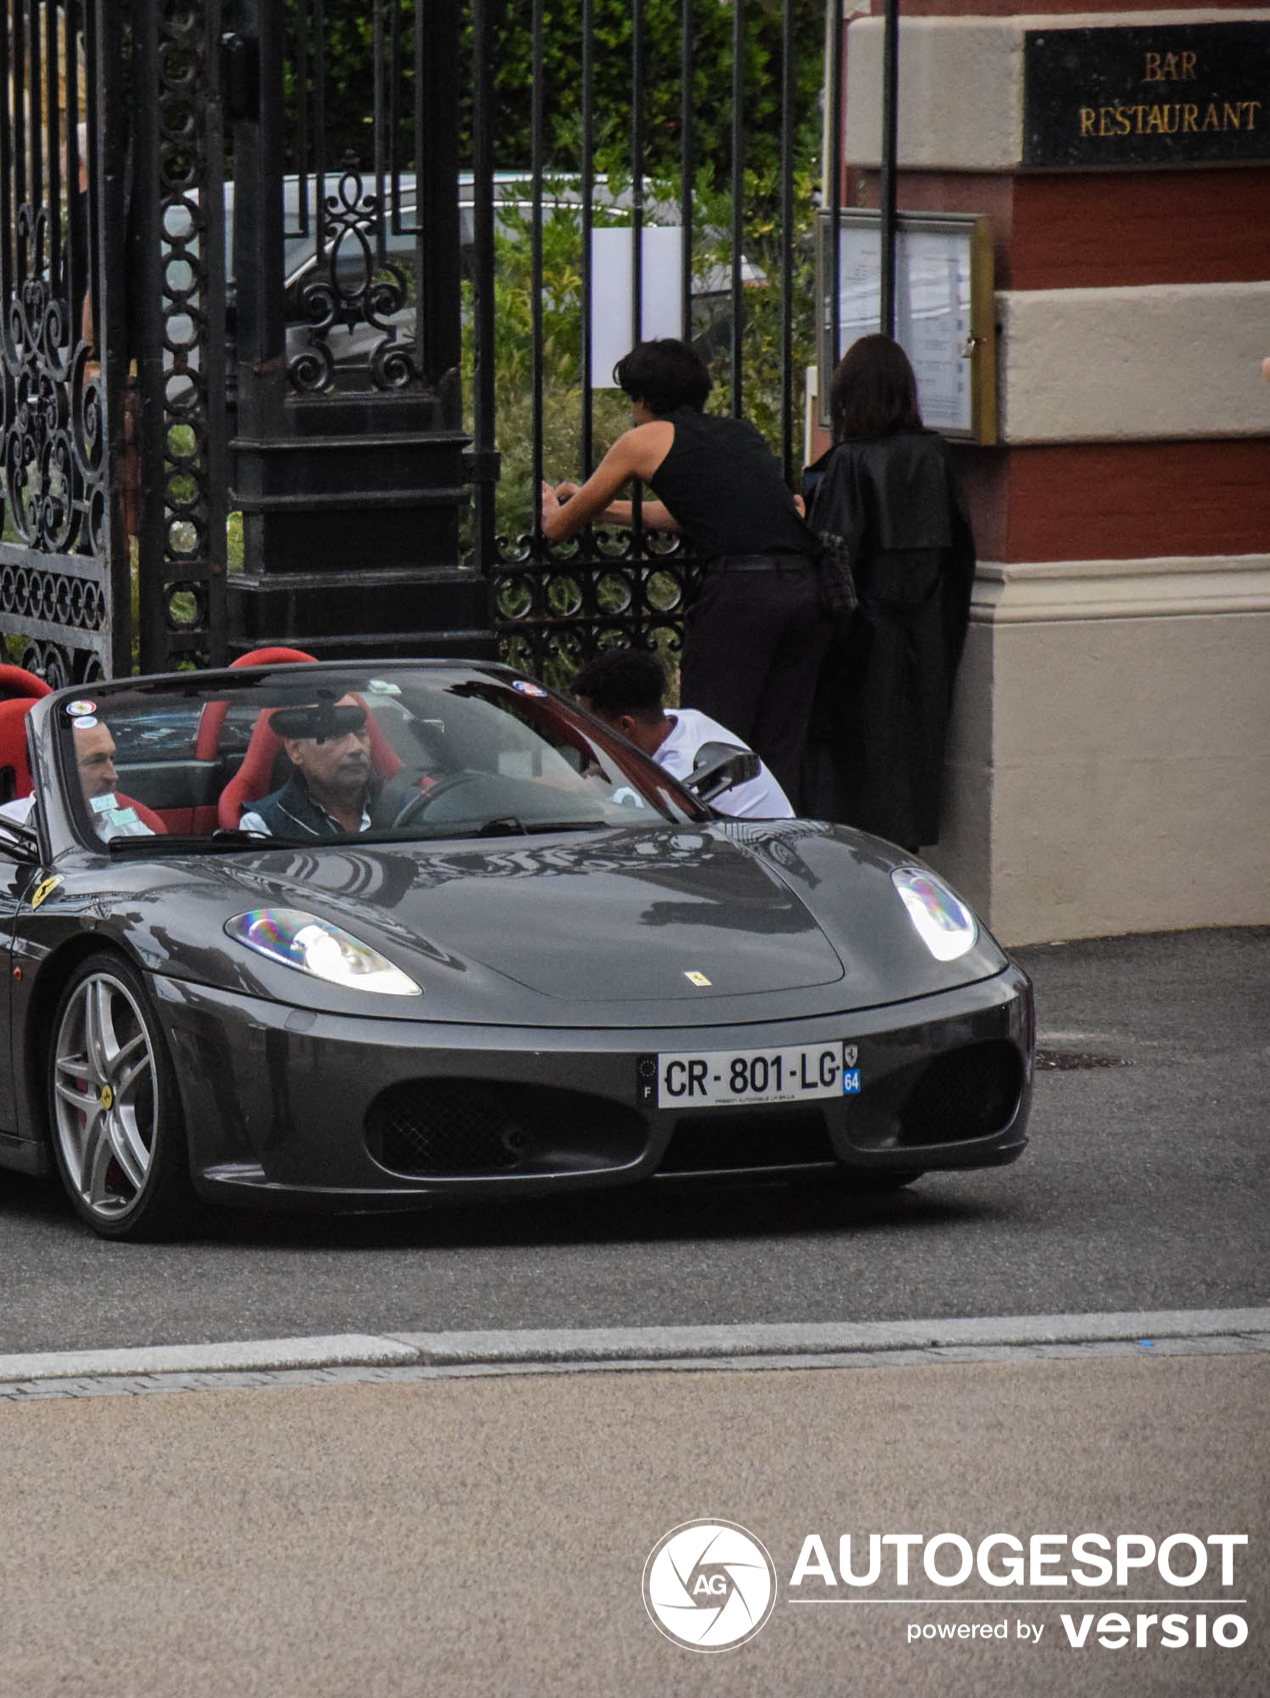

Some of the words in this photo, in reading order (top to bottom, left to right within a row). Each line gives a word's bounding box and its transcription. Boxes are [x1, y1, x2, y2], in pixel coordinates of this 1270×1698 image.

[1142, 51, 1198, 82] BAR
[1080, 101, 1263, 137] RESTAURANT
[643, 1086, 652, 1098] F
[844, 1072, 859, 1091] 64
